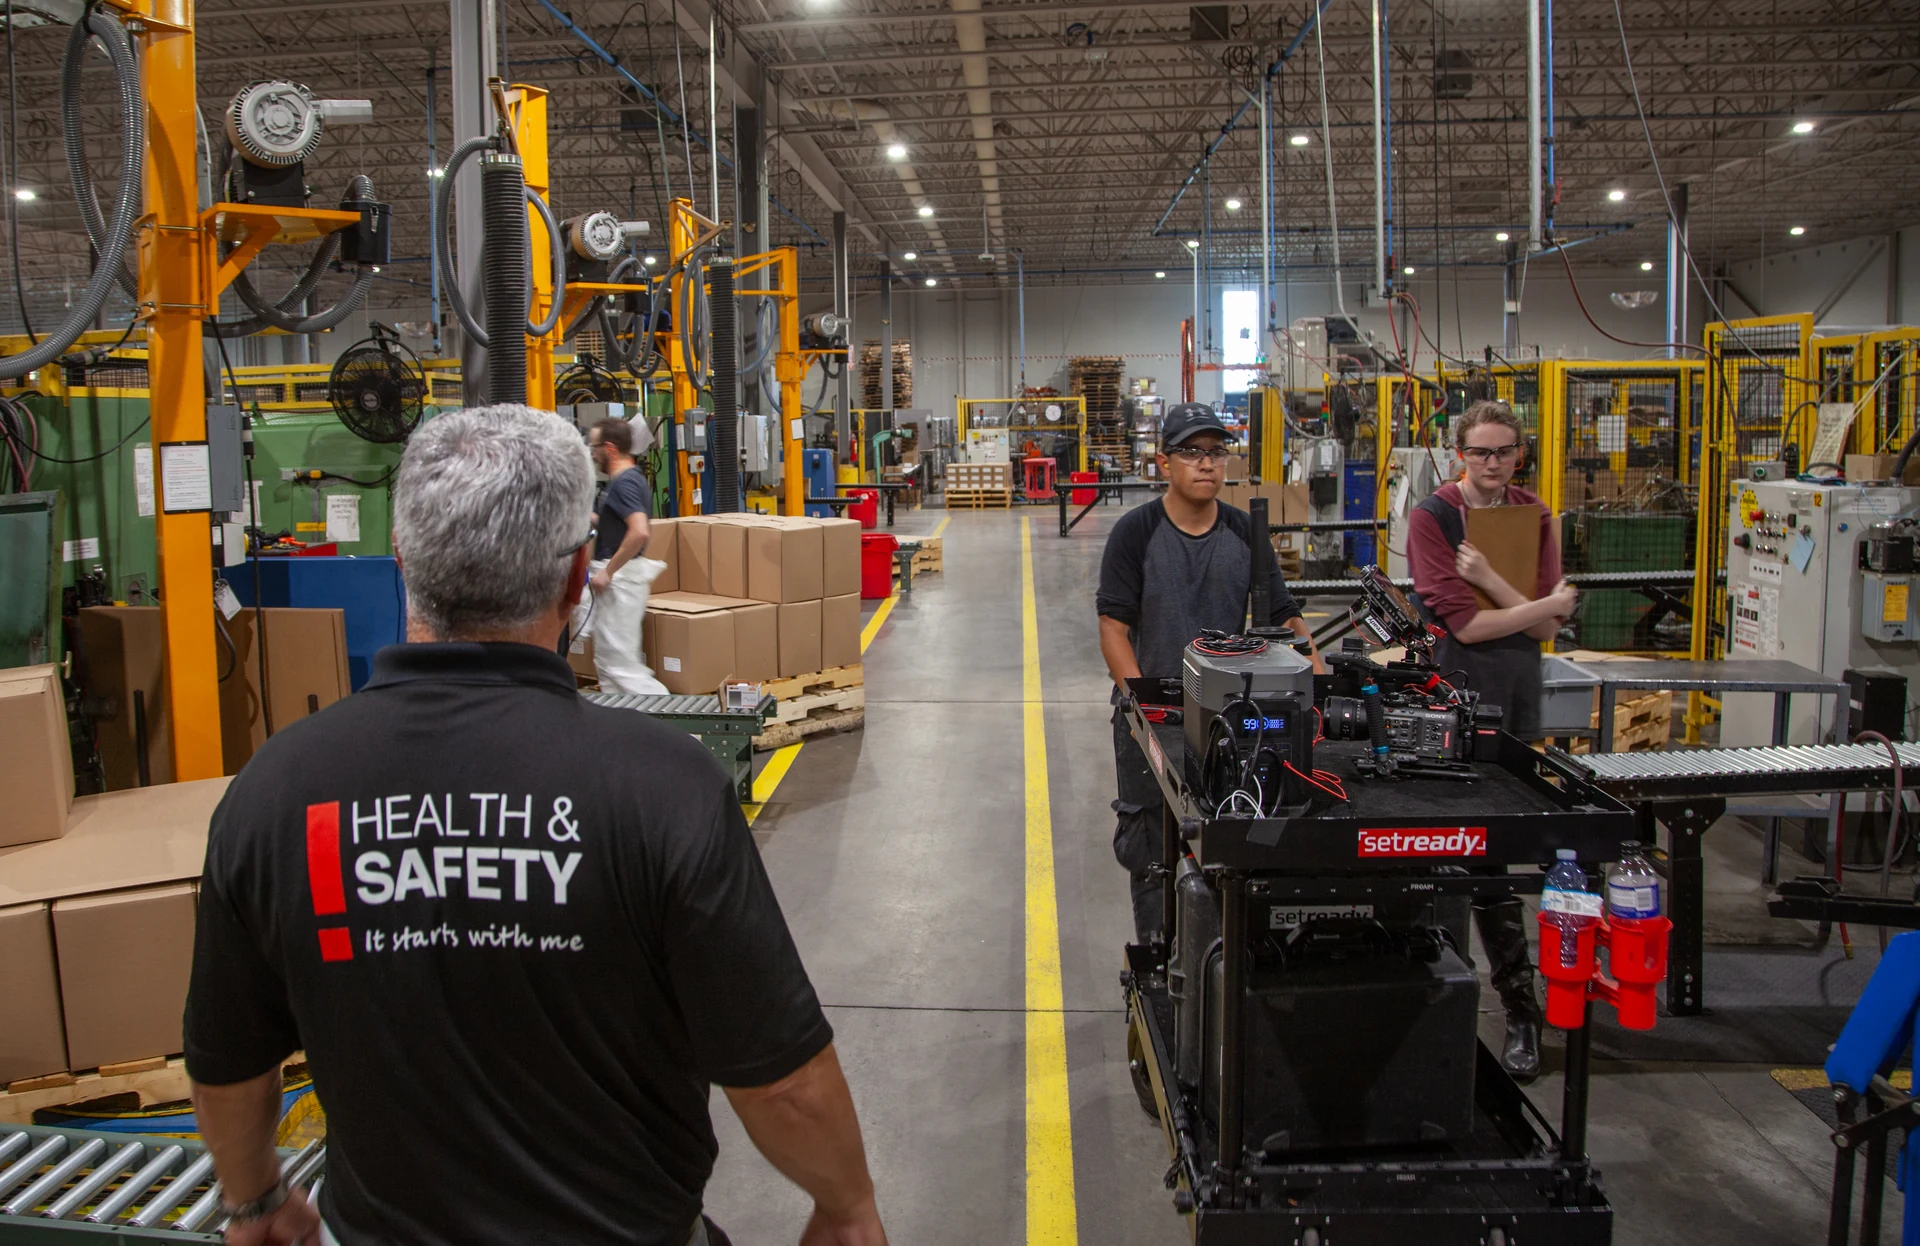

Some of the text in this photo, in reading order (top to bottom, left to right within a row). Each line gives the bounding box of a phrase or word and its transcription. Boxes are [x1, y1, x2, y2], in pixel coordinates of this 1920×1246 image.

[1813, 493, 1822, 507] 12
[1243, 718, 1257, 730] 99
[352, 793, 581, 844] HEALTH &
[1364, 827, 1480, 856] setready
[354, 847, 583, 905] SAFETY
[365, 922, 585, 953] It starts with me
